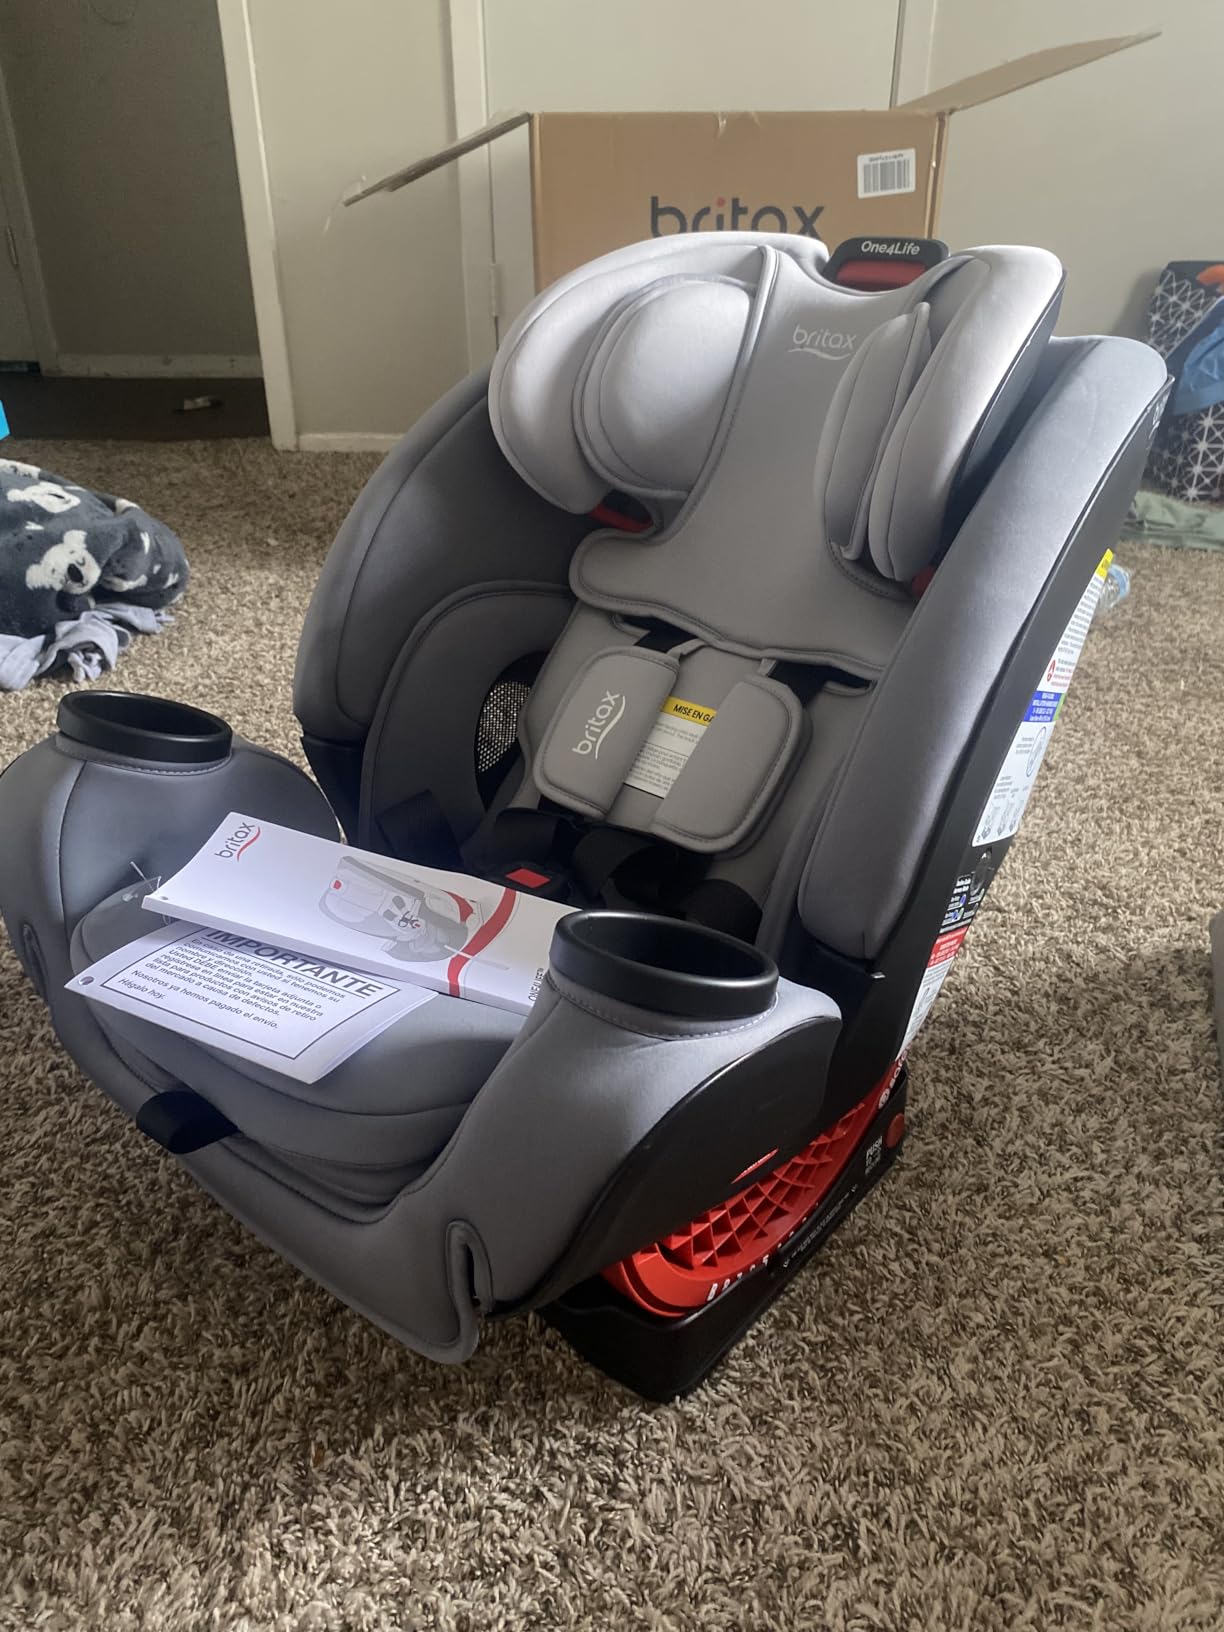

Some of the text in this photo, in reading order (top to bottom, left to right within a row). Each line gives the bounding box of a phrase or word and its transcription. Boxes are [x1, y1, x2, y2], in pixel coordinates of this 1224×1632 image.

[650, 196, 825, 238] britax
[861, 240, 920, 257] One4Life
[792, 325, 857, 351] britax
[572, 690, 620, 756] britax
[673, 703, 693, 717] MISE
[692, 709, 704, 720] EN
[214, 821, 256, 859] britax
[175, 945, 207, 959] nombre
[205, 929, 383, 996] IMPORTANTE
[130, 969, 169, 986] Nosotros
[179, 987, 209, 1002] hemos
[207, 999, 242, 1014] pagado
[144, 962, 160, 970] del
[158, 967, 195, 983] mercado
[202, 984, 228, 995] causa
[240, 998, 281, 1015] defectos.
[168, 948, 194, 960] Usted
[192, 958, 218, 969] DEBE
[216, 968, 243, 979] enviar
[252, 980, 280, 993] tarjeta
[280, 991, 314, 1006] adjunta
[168, 964, 190, 974] para
[188, 972, 232, 989] productos
[232, 987, 250, 996] con
[249, 994, 278, 1007] avisos
[291, 1009, 316, 1020] retiro
[239, 963, 256, 971] con
[256, 969, 282, 980] usted
[290, 981, 327, 998] tenemos
[303, 981, 345, 998] podemos
[231, 980, 254, 990] para
[253, 988, 277, 998] estar
[289, 1001, 323, 1016] nuestra
